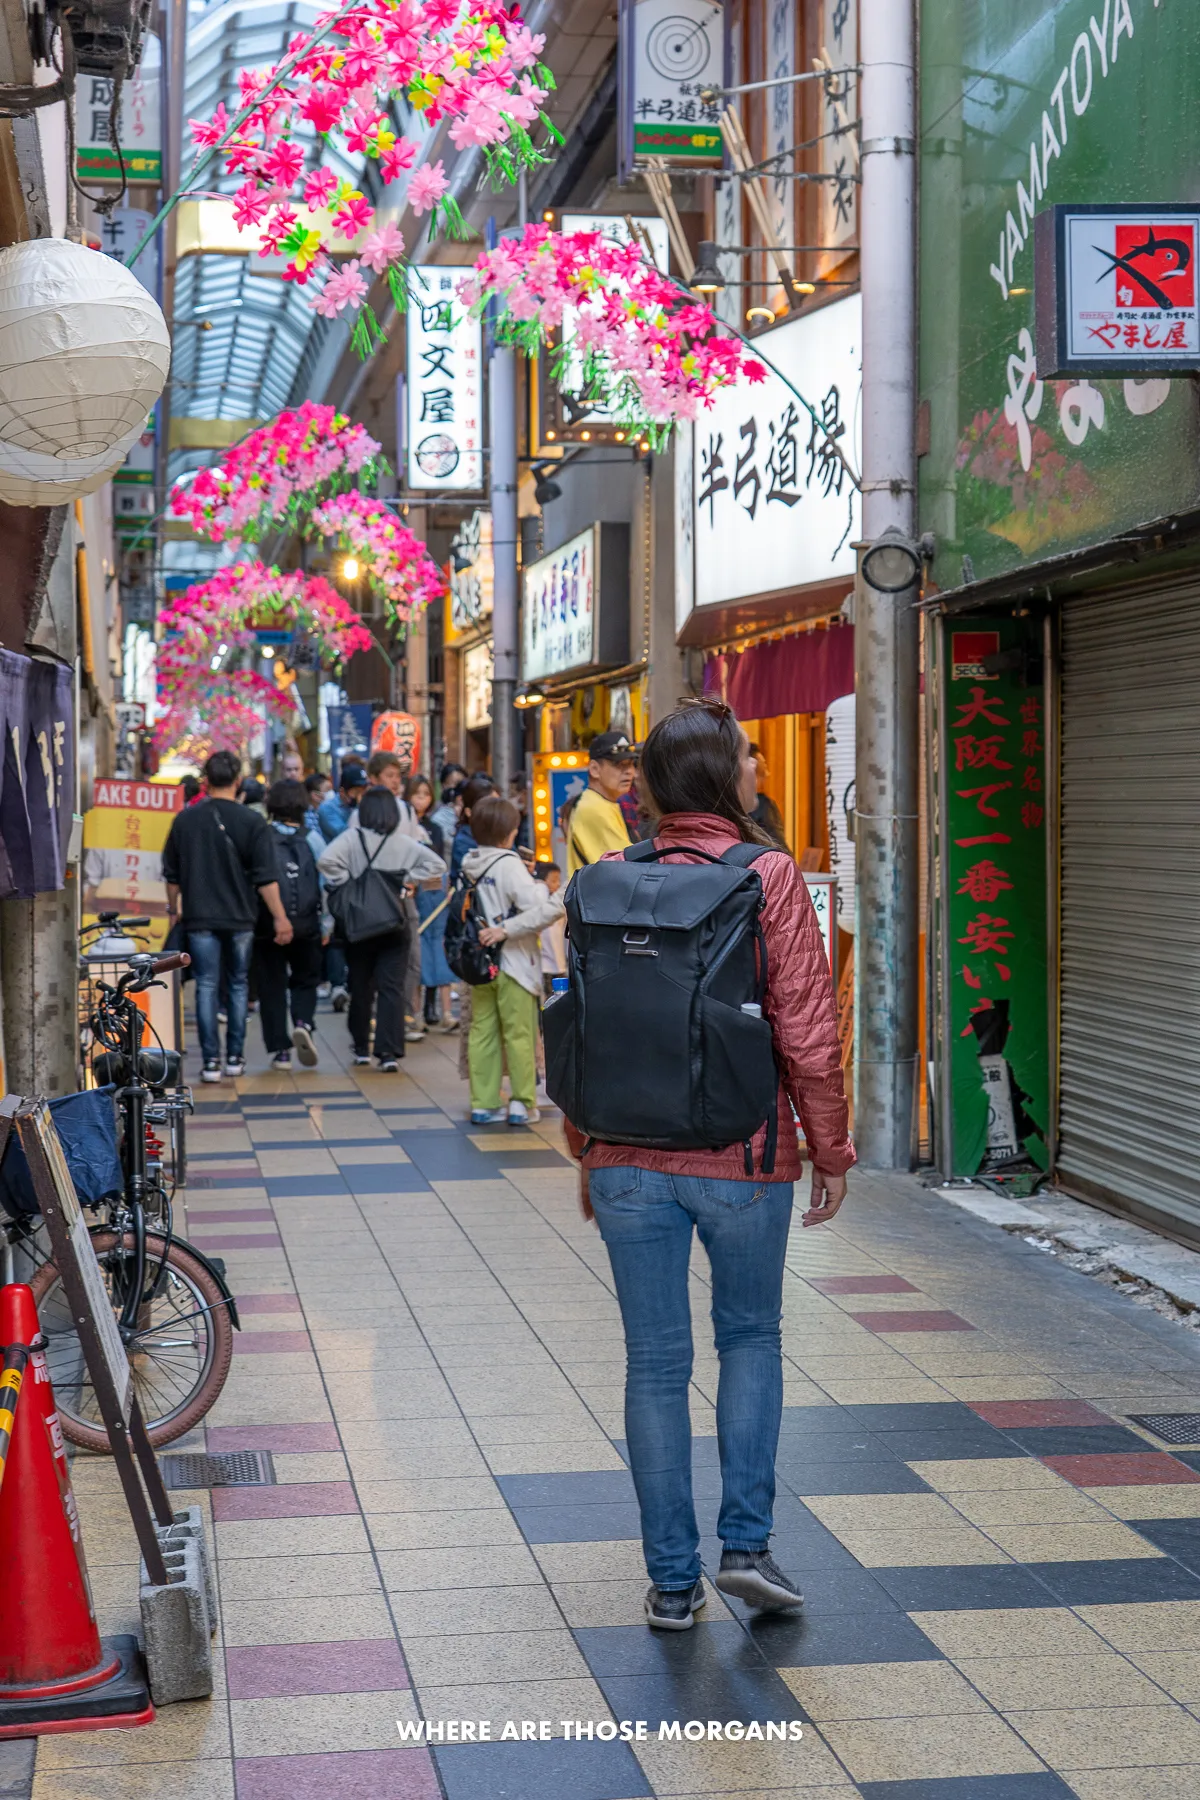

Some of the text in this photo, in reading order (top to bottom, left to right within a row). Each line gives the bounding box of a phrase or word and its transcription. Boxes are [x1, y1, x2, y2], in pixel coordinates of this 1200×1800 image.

[634, 97, 720, 123] 半弓道場
[1118, 285, 1133, 306] 旬
[1086, 320, 1188, 349] やまと屋
[419, 301, 455, 422] 四文屋
[699, 384, 846, 529] 半弓道場
[955, 665, 993, 676] SECO
[1019, 696, 1044, 829] 世界名物
[136, 786, 177, 809] OUT
[125, 814, 141, 915] 台湾カステラ
